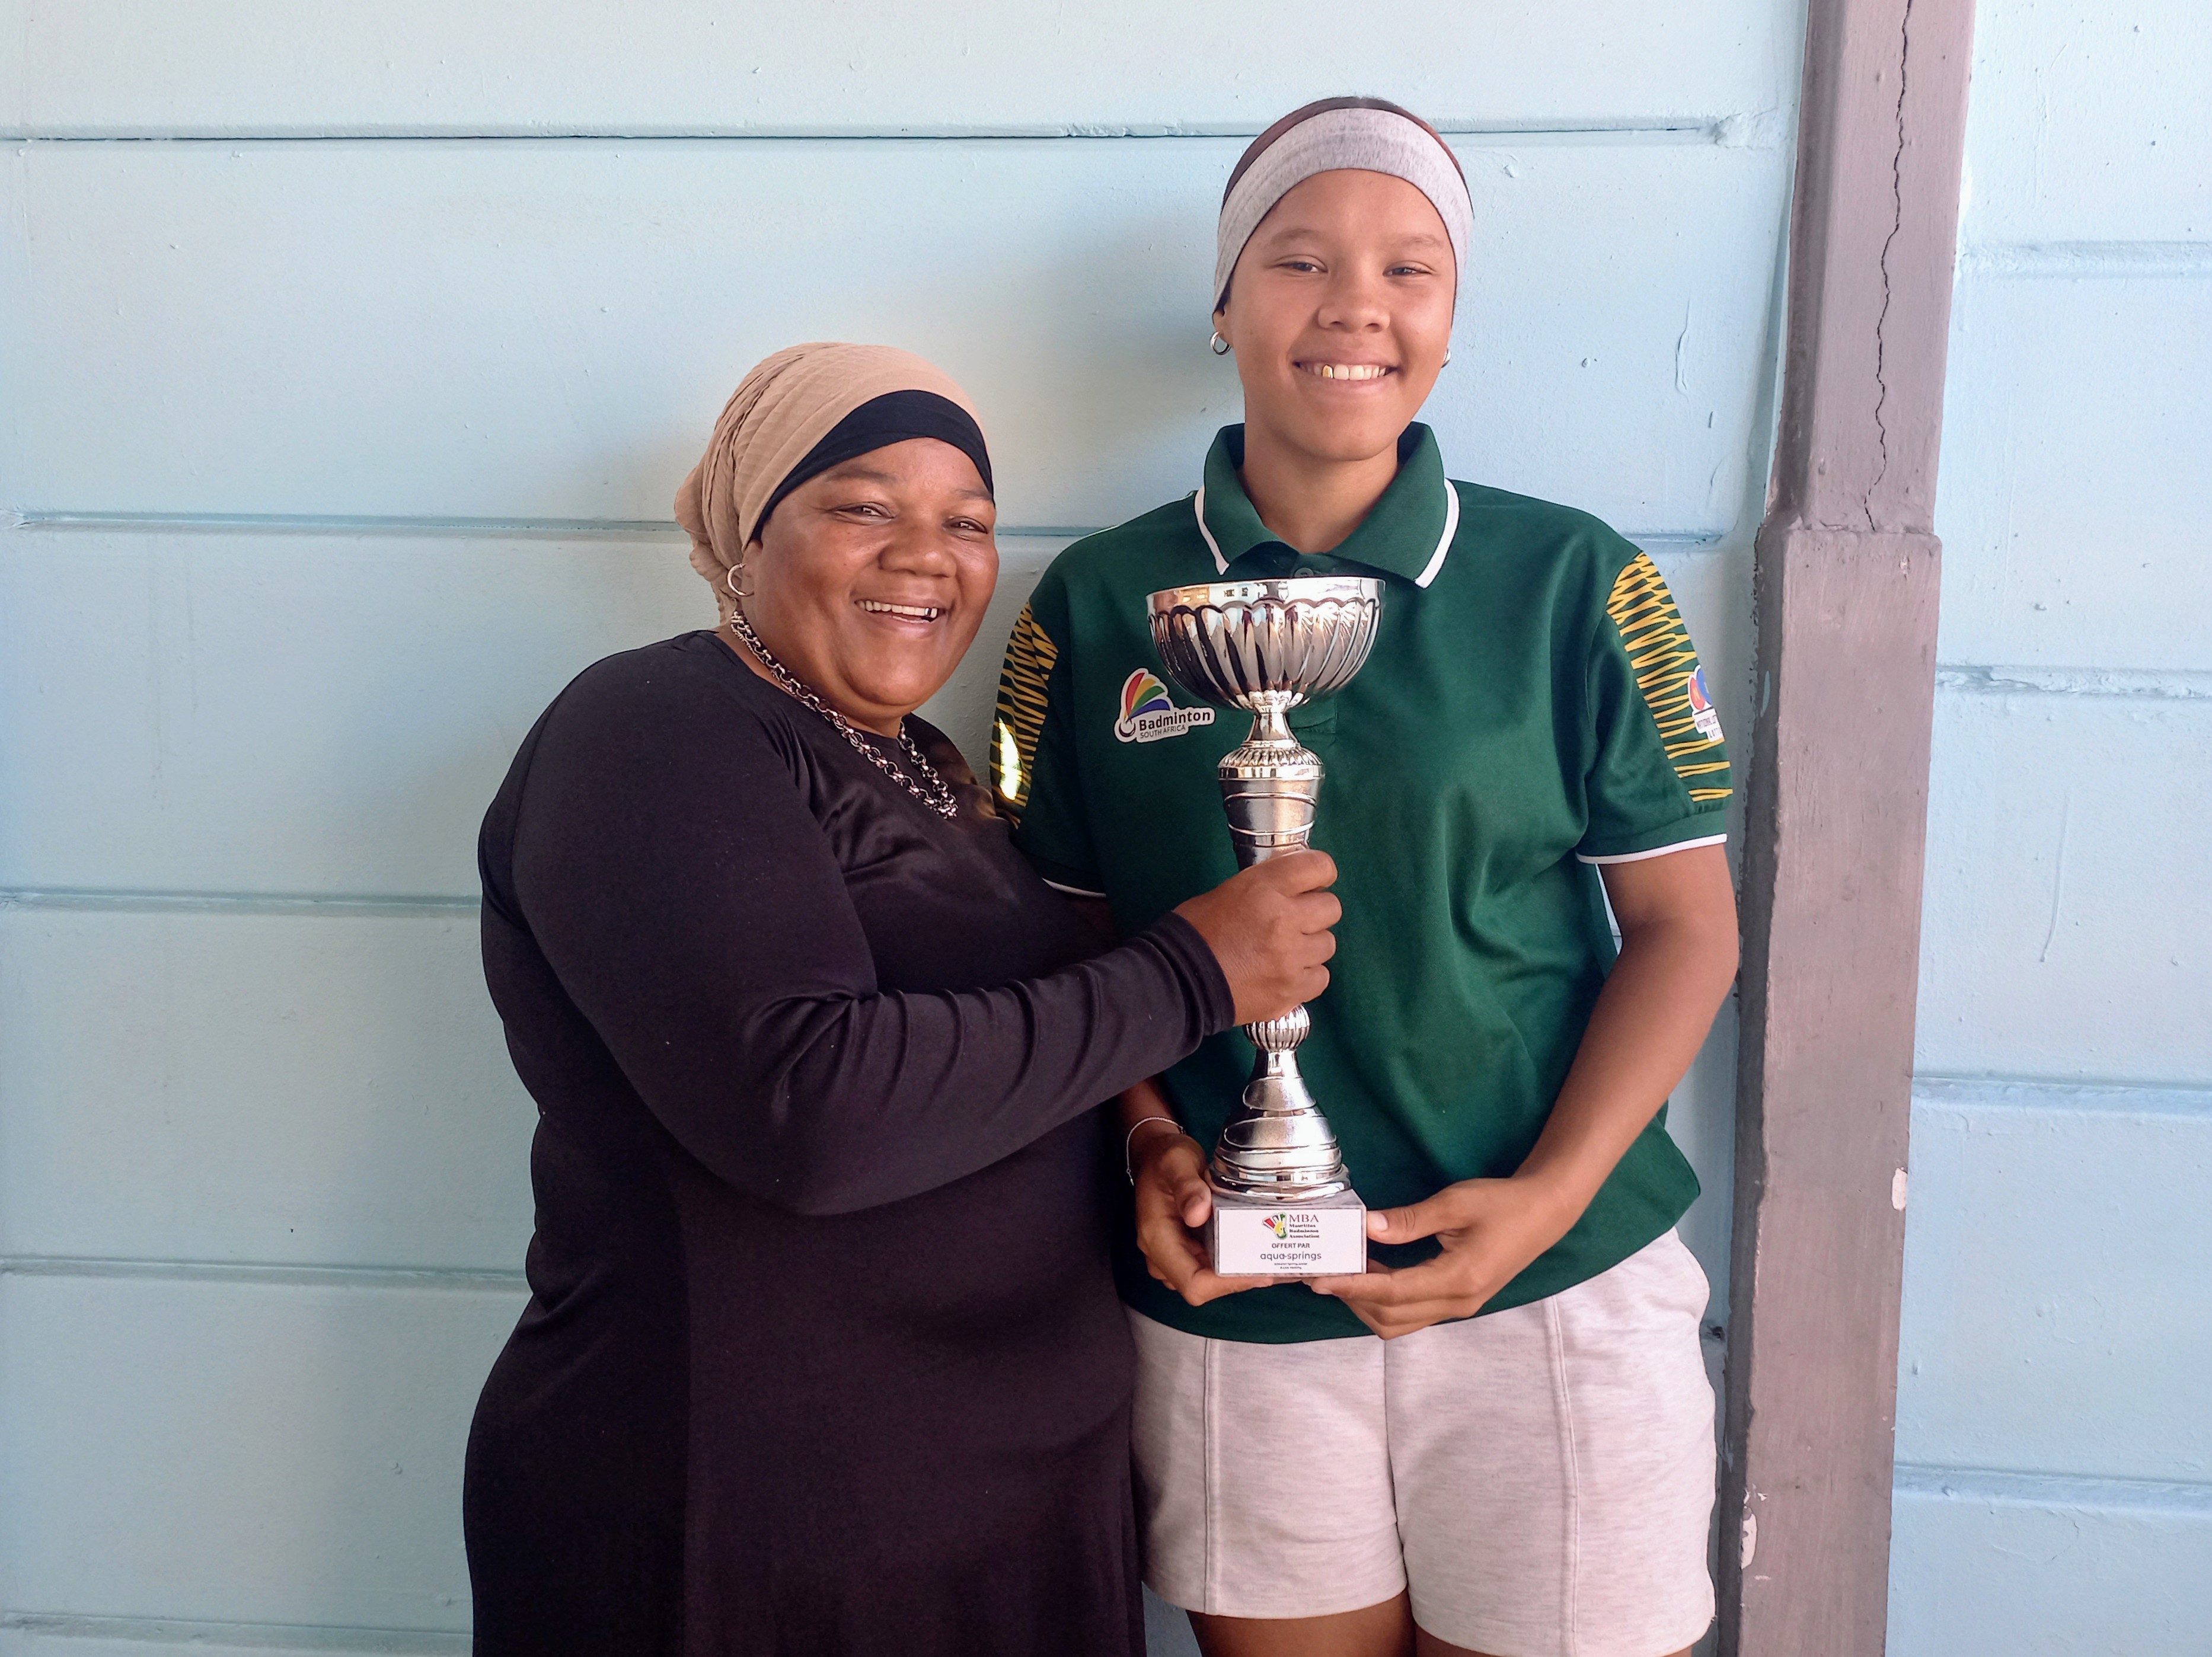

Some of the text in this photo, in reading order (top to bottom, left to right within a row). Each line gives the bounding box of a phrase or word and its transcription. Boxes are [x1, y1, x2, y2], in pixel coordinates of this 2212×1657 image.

[1139, 711, 1210, 730] Badminton
[1140, 724, 1186, 739] SOUTH AFRICA
[1289, 1214, 1319, 1222] MBA
